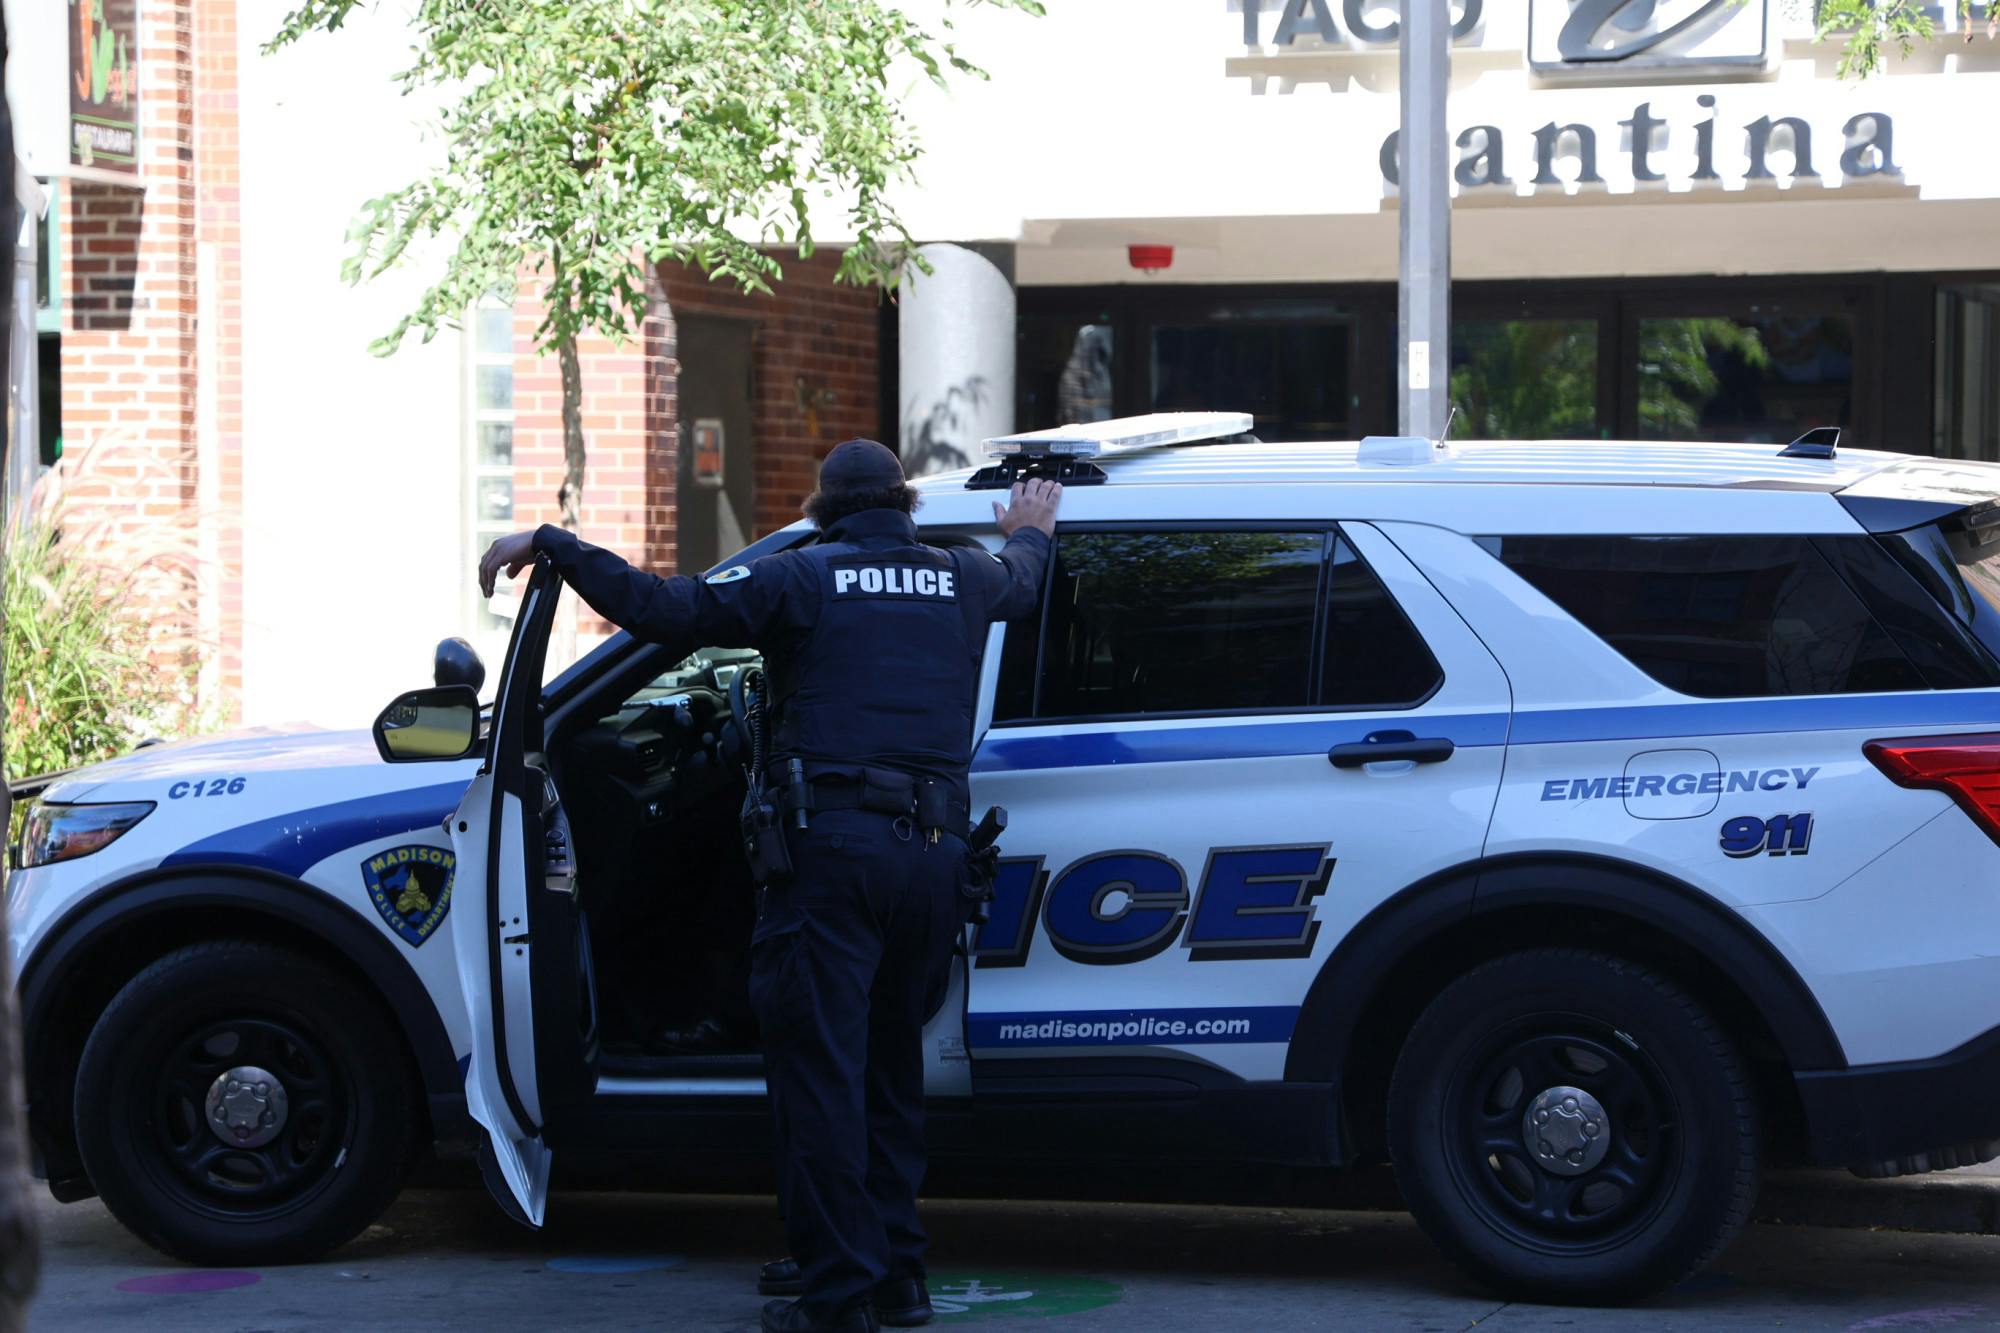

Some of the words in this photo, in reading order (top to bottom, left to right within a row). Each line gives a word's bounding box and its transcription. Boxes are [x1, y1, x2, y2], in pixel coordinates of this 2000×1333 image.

[1243, 0, 1483, 45] TAC
[834, 567, 955, 597] POLICE
[168, 777, 247, 799] C126
[1540, 767, 1820, 801] EMERGENCY
[1719, 812, 1814, 859] 911
[369, 848, 455, 874] MADISON
[371, 884, 405, 930] POLICE
[999, 1017, 1250, 1041] madisonpolice.com
